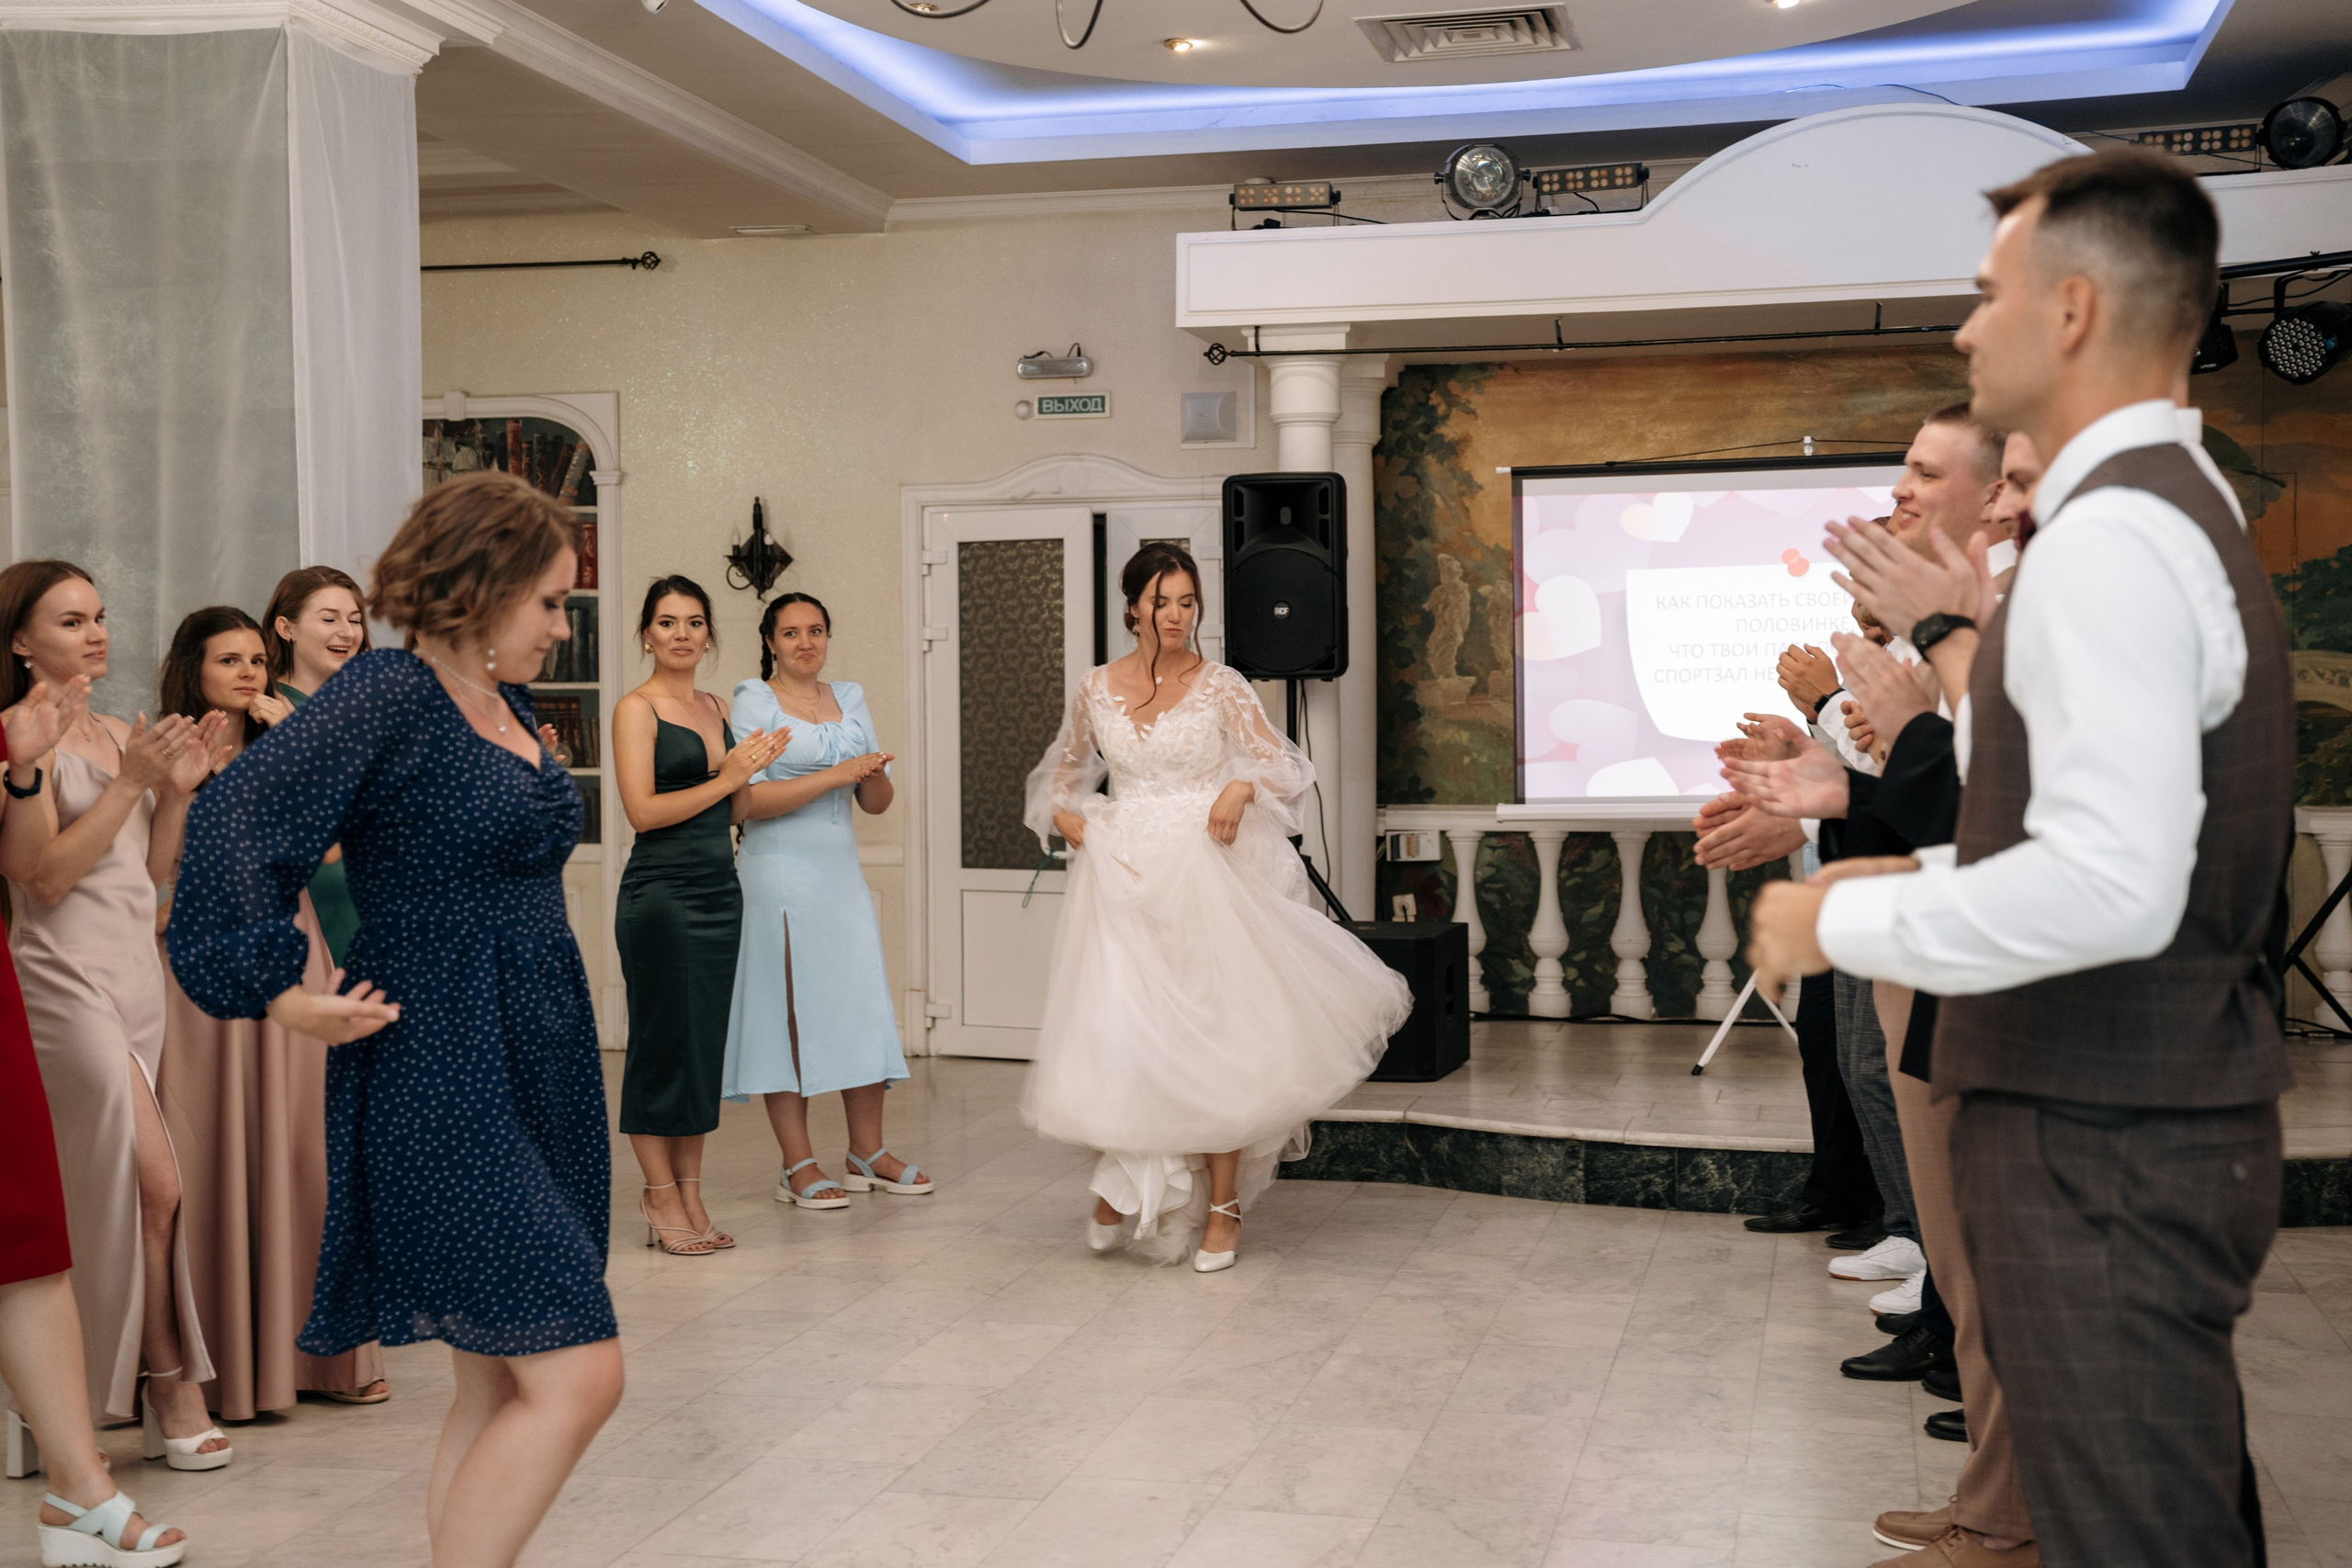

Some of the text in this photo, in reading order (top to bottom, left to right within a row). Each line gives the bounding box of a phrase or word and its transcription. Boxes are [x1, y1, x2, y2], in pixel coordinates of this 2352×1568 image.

[1042, 398, 1103, 412] ВЫХОД
[1657, 596, 1690, 611] КАК
[1696, 593, 1789, 609] ПОКАЗАТЬ
[1736, 616, 1854, 633] ПОЛОВИНКЕ,
[1669, 644, 1703, 659] ЧТО
[1709, 643, 1758, 658] ТВОИ
[1655, 667, 1777, 682] СПОРТЗАЛ НЕ
